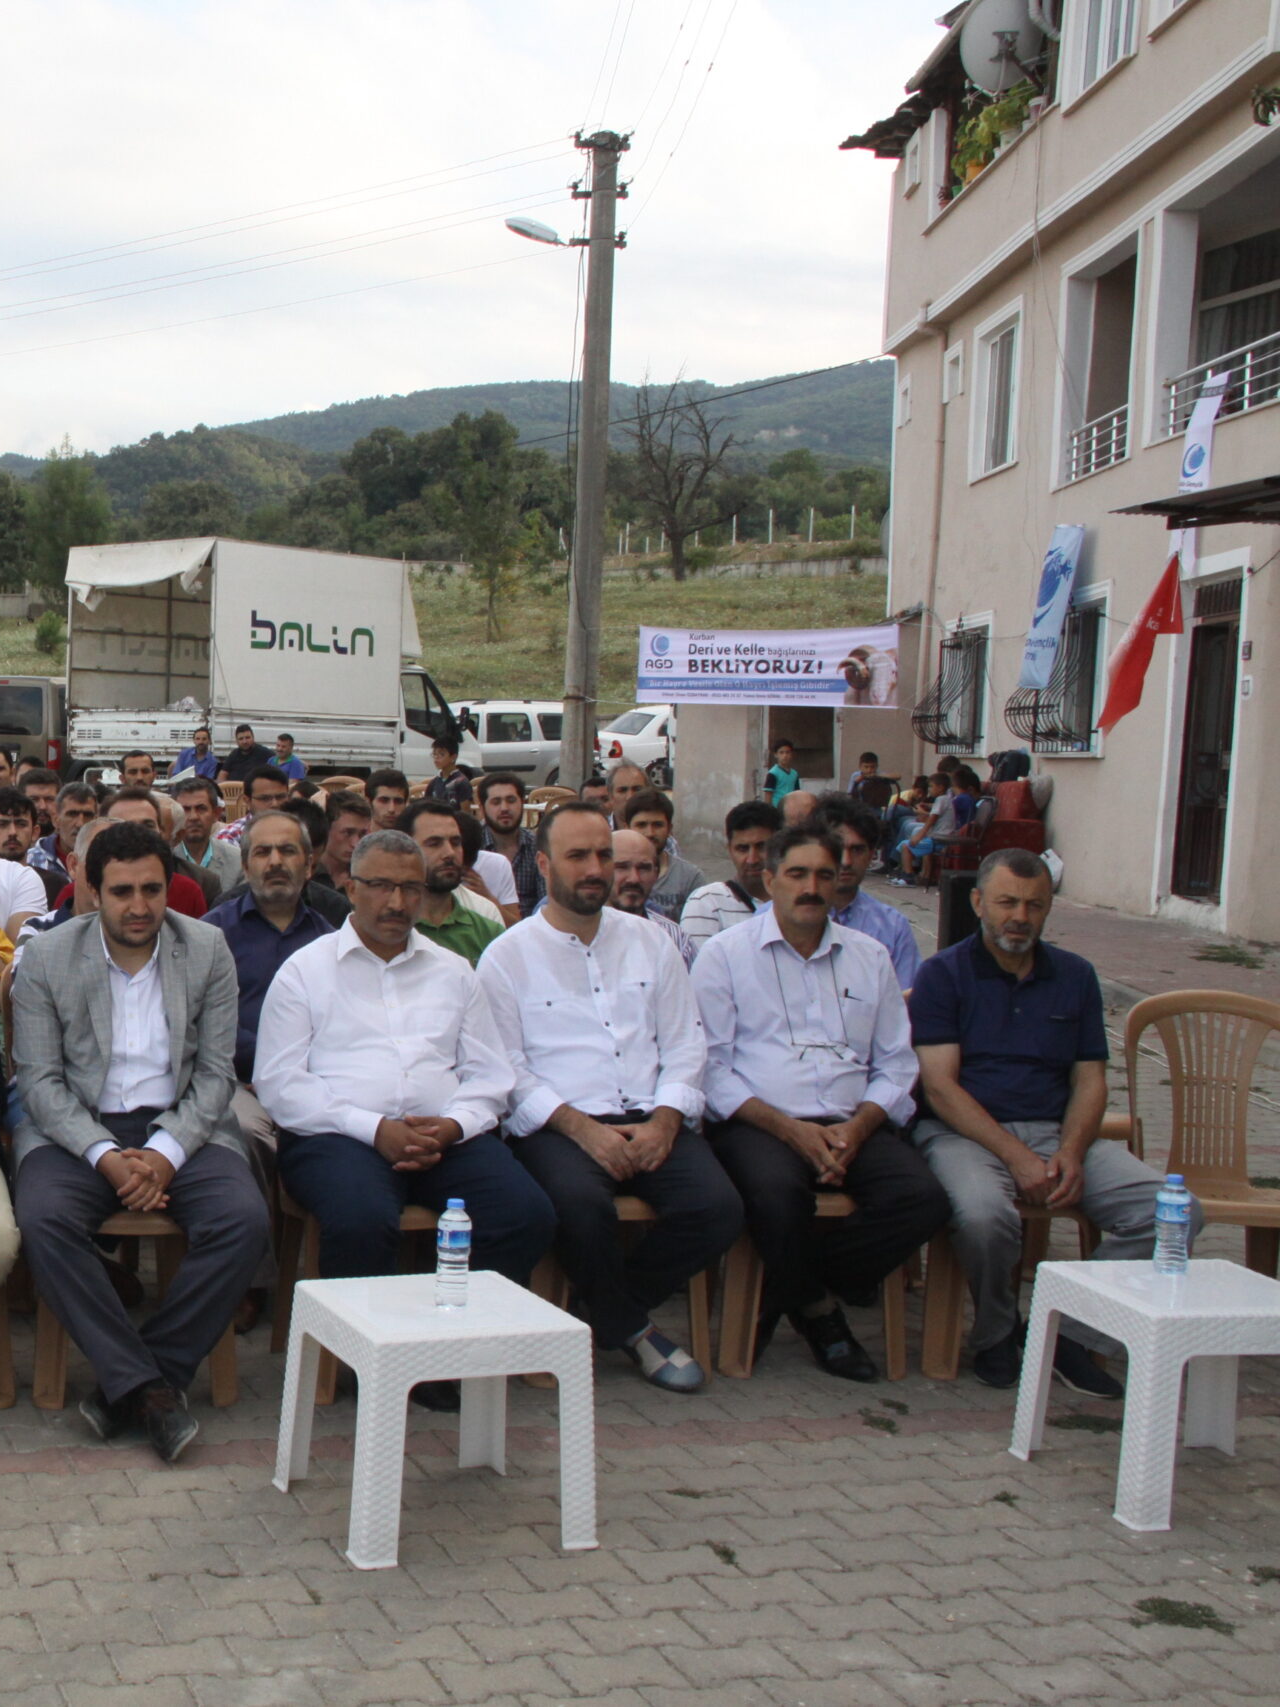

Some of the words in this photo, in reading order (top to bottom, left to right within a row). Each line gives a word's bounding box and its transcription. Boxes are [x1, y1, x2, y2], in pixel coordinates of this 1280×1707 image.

[689, 633, 715, 641] Kurban
[688, 643, 714, 655] Deri
[717, 647, 731, 655] ve
[734, 643, 765, 655] Kelle
[645, 659, 673, 669] AGD
